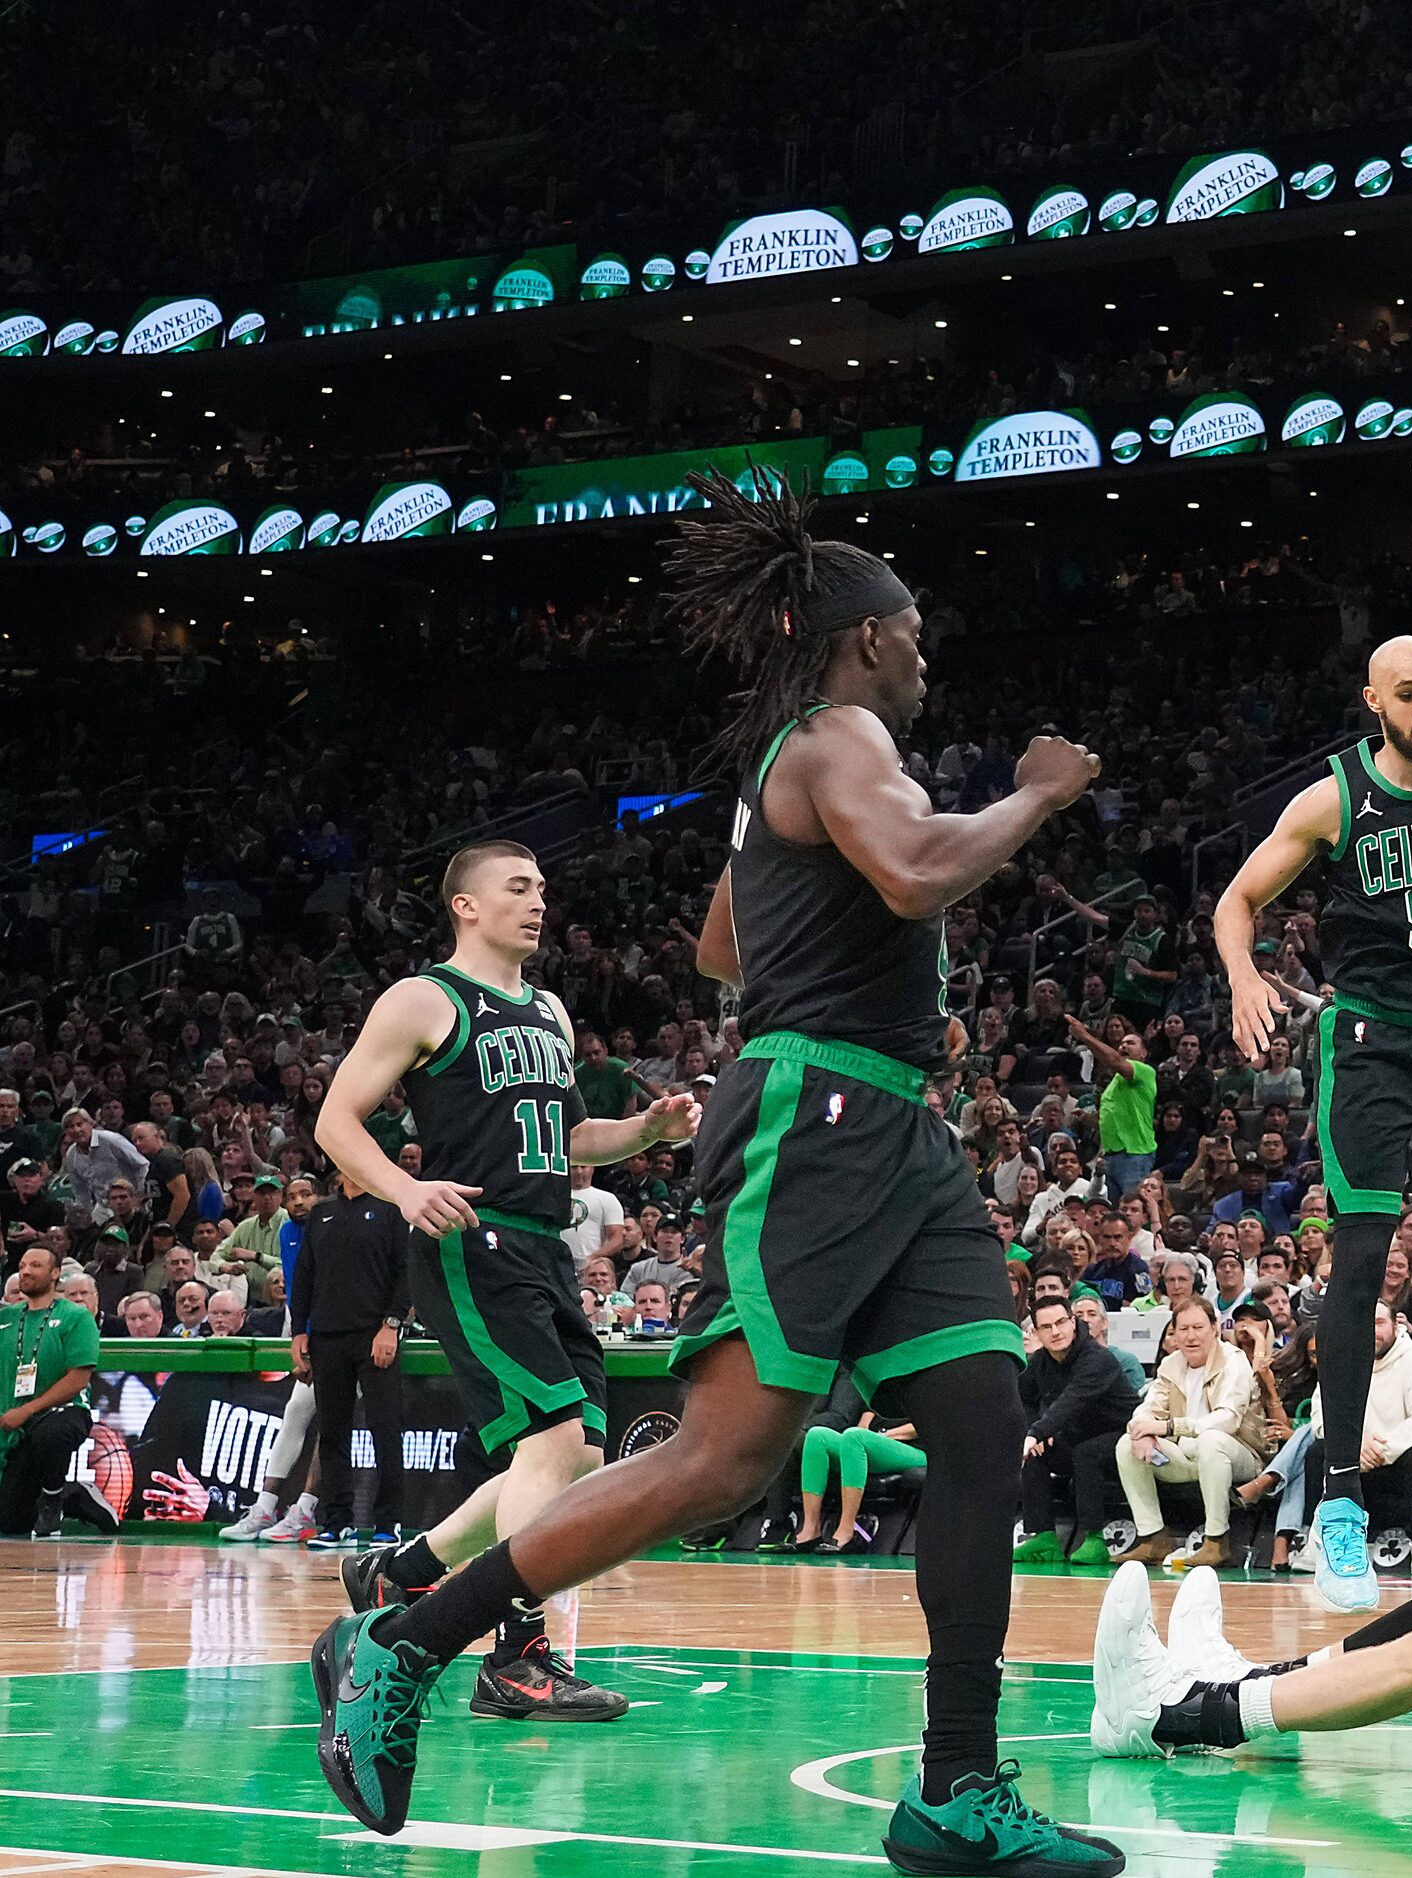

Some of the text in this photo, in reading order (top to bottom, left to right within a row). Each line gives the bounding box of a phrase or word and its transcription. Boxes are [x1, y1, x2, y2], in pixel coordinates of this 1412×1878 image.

[1175, 159, 1257, 216] FRANKLIN
[931, 207, 998, 234] FRANKLIN
[1032, 200, 1083, 231] TEMPLETON
[1034, 195, 1078, 222] FRANKLIN
[730, 229, 838, 256] FRANKLIN
[926, 218, 1006, 247] TEMPLETON
[719, 249, 847, 277] TEMPLETON
[133, 305, 207, 344] FRANKLIN
[1182, 411, 1251, 439] FRANKLIN
[1286, 410, 1338, 437] TEMPLETON
[1288, 404, 1333, 428] FRANKLIN
[977, 430, 1082, 457] FRANKLIN
[1177, 422, 1258, 451] TEMPLETON
[967, 447, 1091, 477] TEMPLETON
[370, 489, 436, 535] FRANKLIN
[149, 512, 220, 552] FRANKLIN
[153, 520, 230, 556] EMPLETON
[513, 1099, 569, 1176] 11
